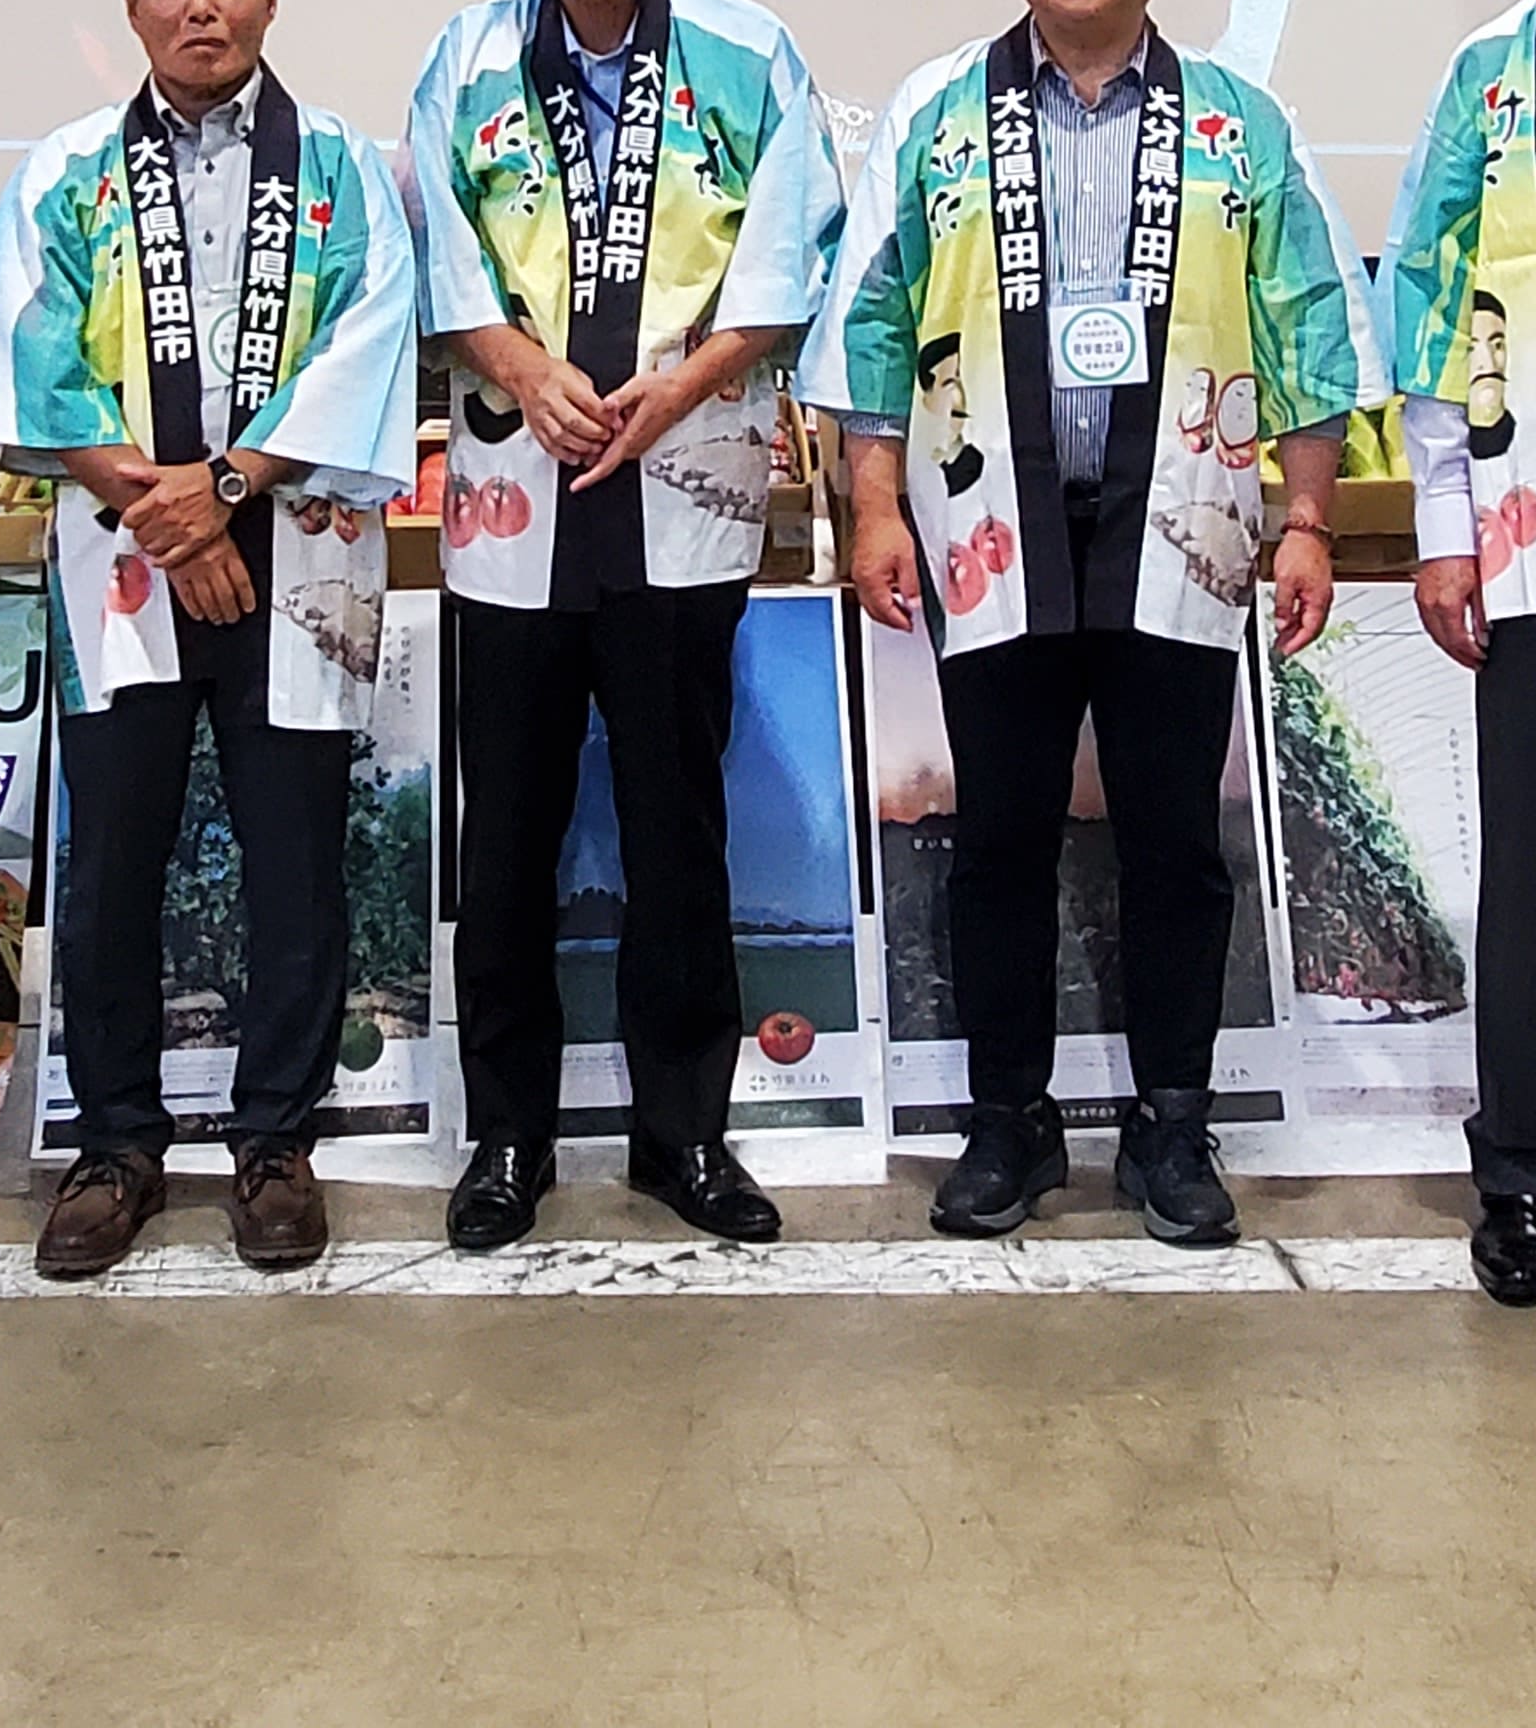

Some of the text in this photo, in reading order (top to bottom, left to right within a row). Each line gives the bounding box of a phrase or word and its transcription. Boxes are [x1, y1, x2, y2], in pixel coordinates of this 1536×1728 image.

[127, 135, 193, 366] 大分県竹田市
[601, 49, 664, 283] 大分県竹田市
[990, 87, 1042, 312] 大分県竹田市
[1129, 85, 1181, 308] 大分県竹田市
[234, 175, 296, 411] 大分県竹田市
